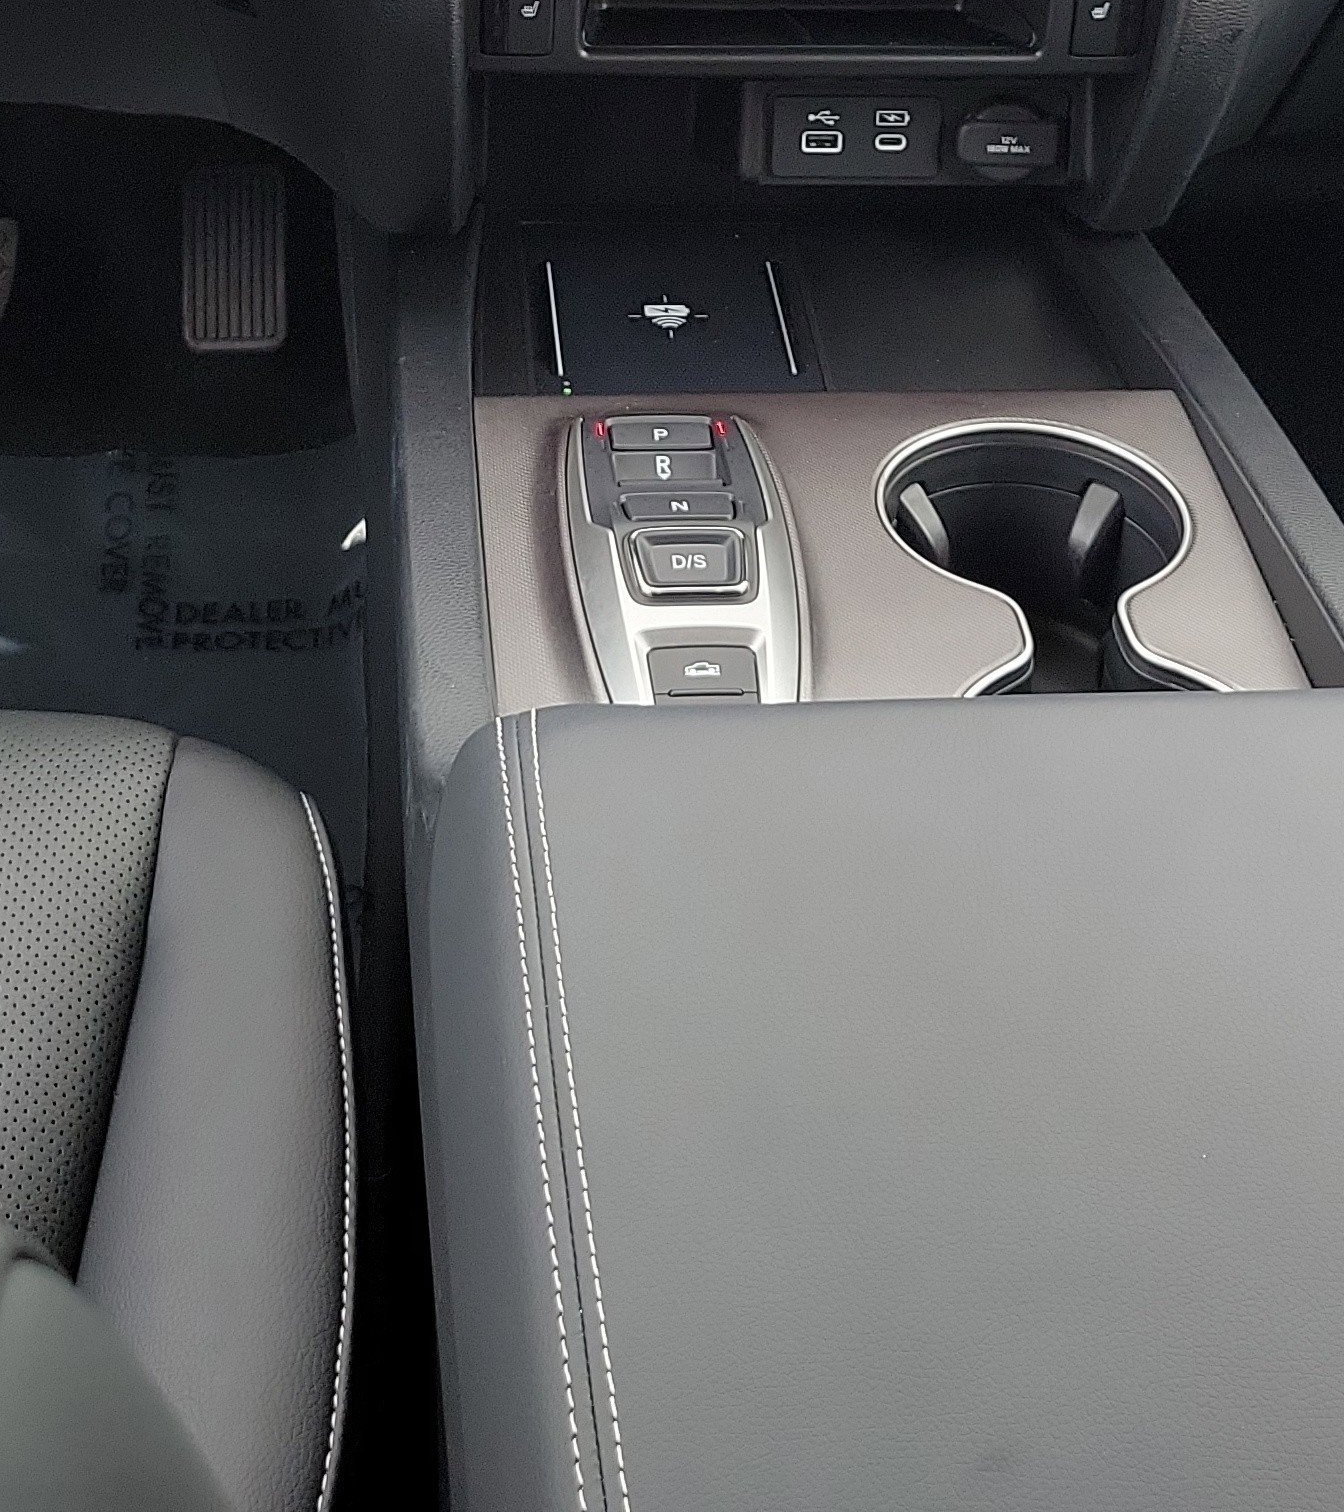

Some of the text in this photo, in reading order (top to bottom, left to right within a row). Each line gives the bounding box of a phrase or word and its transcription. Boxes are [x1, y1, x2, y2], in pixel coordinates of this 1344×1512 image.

[653, 428, 668, 441] P
[655, 455, 670, 471] R
[670, 501, 689, 512] N
[671, 554, 707, 569] D/S
[175, 598, 305, 626] DEALER
